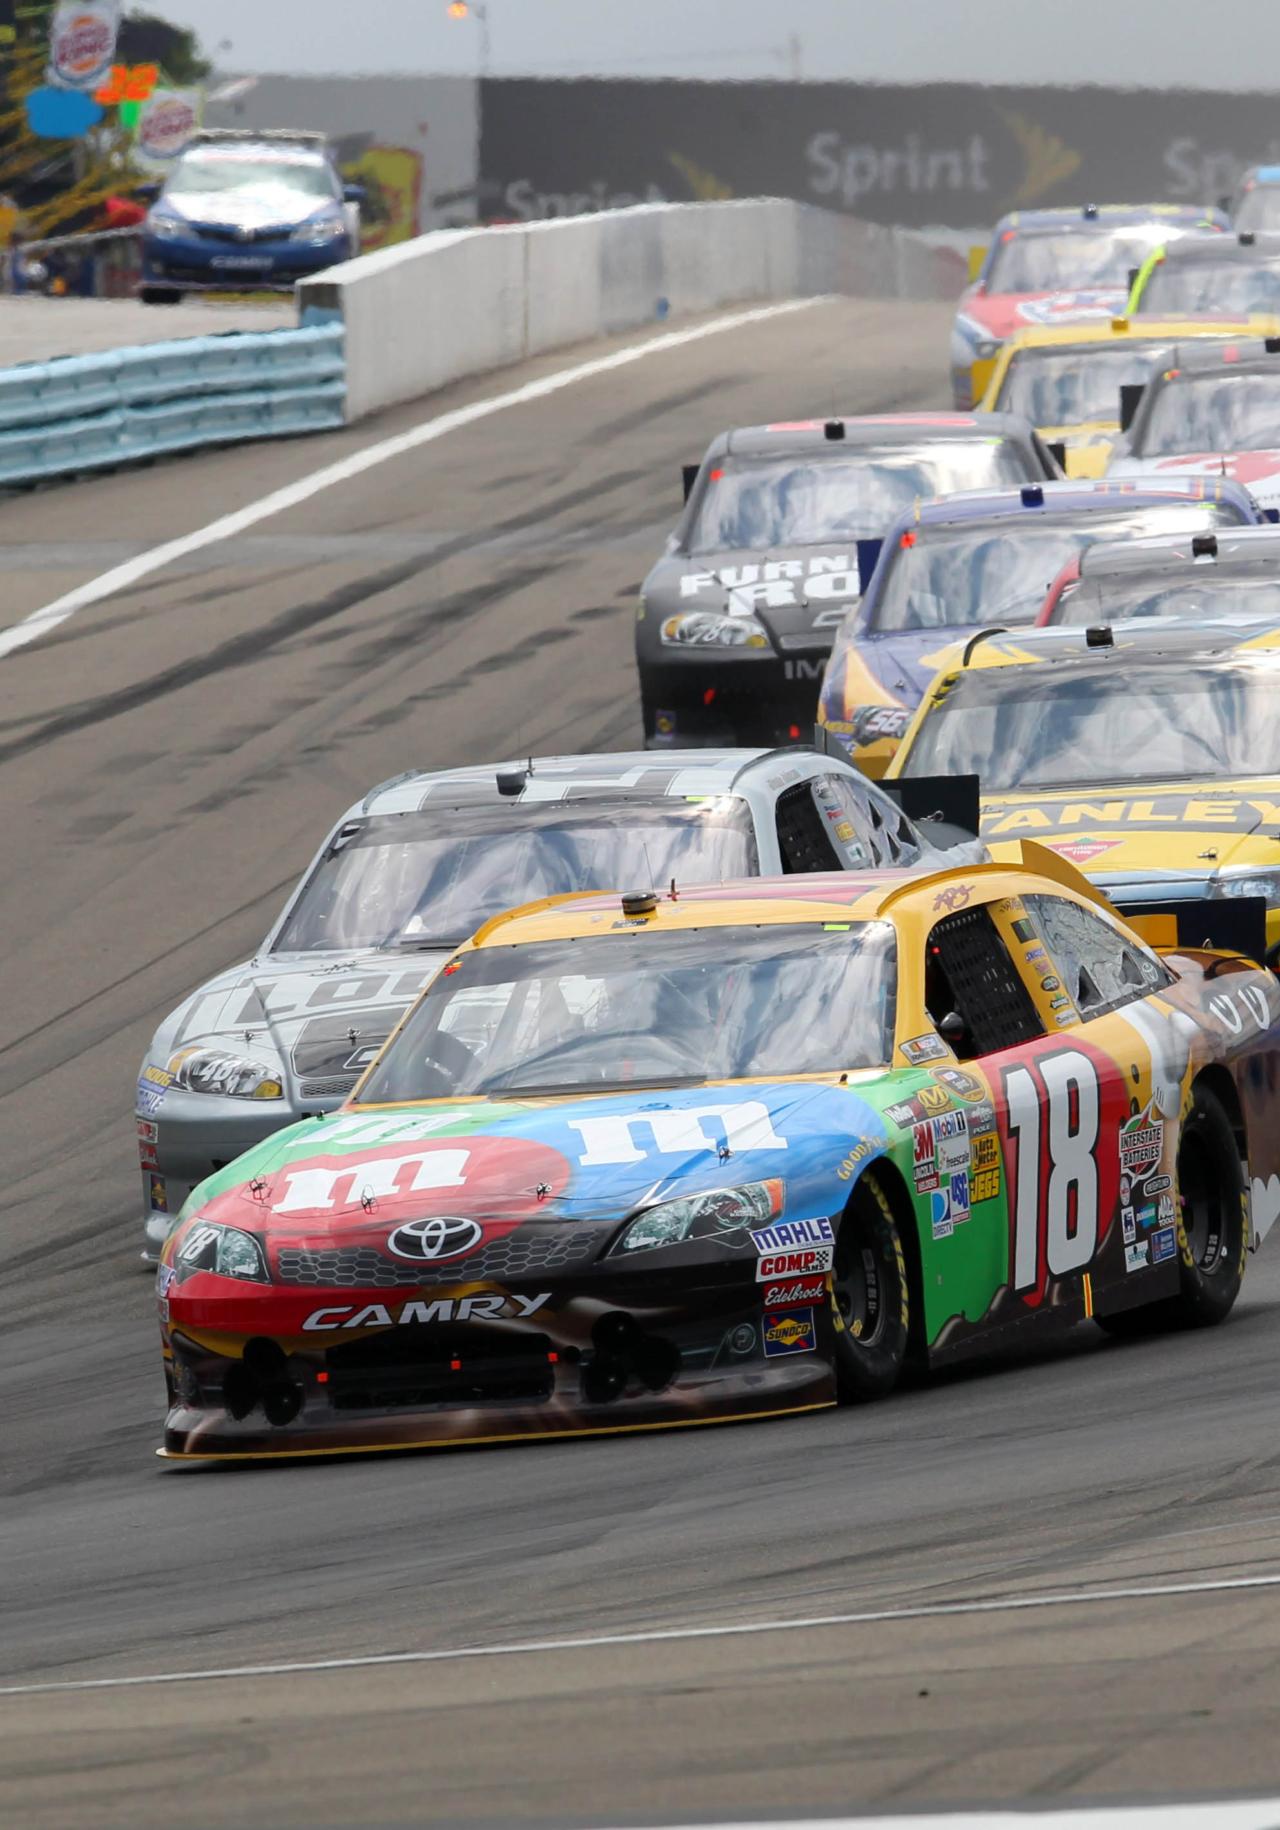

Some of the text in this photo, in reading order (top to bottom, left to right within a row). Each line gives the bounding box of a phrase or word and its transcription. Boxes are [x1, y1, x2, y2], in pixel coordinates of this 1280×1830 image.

[807, 132, 989, 208] Sprint
[680, 554, 858, 598] FURN
[865, 709, 910, 733] 56
[567, 1100, 788, 1166] m
[914, 1120, 935, 1163] 3M
[934, 1114, 958, 1142] Mobil
[956, 1111, 967, 1133] 1
[973, 1124, 991, 1135] POLE
[1120, 1127, 1162, 1148] INTERSTATE
[1006, 1050, 1099, 1292] 18
[1122, 1144, 1160, 1166] BATTERIES
[272, 1148, 471, 1215] m
[970, 1171, 1000, 1203] JEGS
[177, 1226, 221, 1260] 18
[753, 1216, 832, 1250] MAHLE
[760, 1251, 816, 1277] COMP
[799, 1263, 826, 1274] CAMS
[764, 1278, 825, 1307] Edelbrock
[301, 1291, 552, 1331] CAMRY
[765, 1321, 811, 1341] SUNOCO
